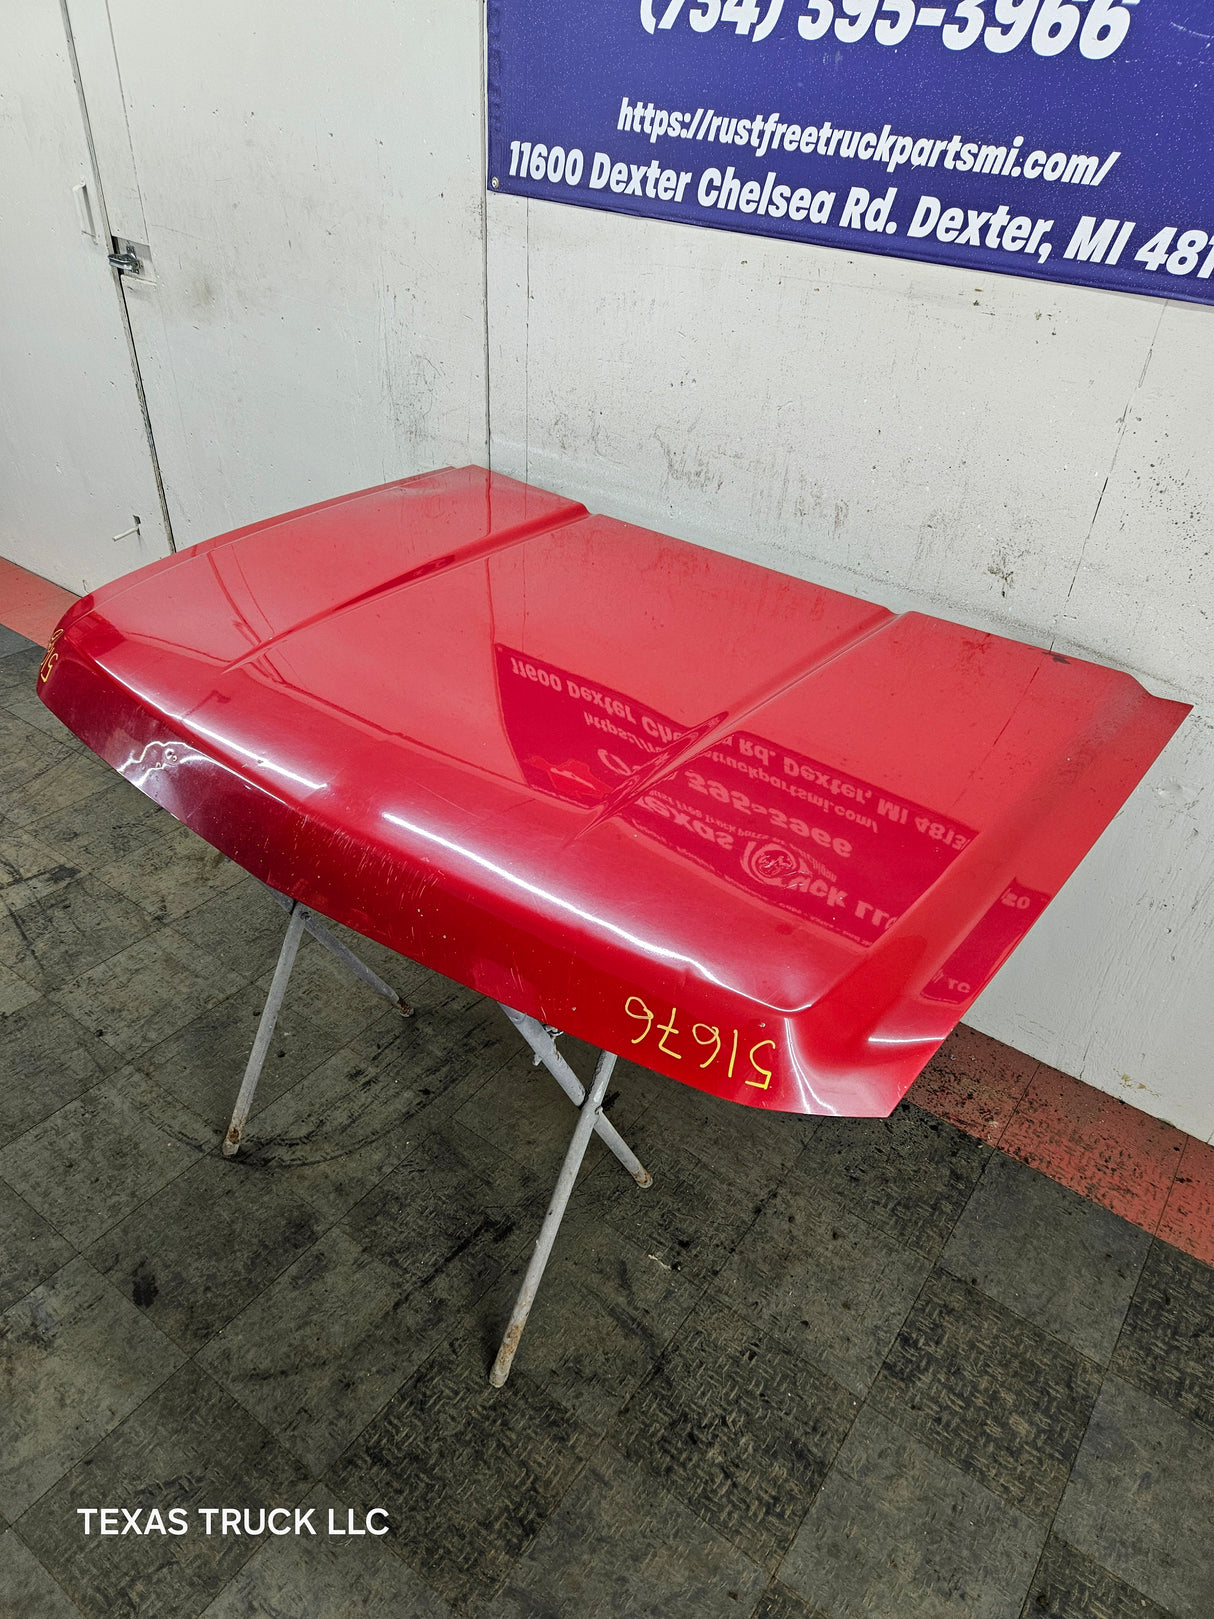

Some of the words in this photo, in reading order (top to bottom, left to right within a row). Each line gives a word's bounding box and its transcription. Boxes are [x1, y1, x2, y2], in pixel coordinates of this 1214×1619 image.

[798, 0, 1140, 60] 395-3966
[617, 97, 1121, 186] https://rustfreetruckpartsmi.com/
[509, 141, 584, 186] 11600
[589, 152, 692, 202] Dexter
[698, 167, 835, 225] Chelsea
[839, 186, 898, 235] Rd.
[907, 195, 1054, 264] Dexter,
[1063, 216, 1136, 265] MI
[625, 996, 776, 1090] 51676
